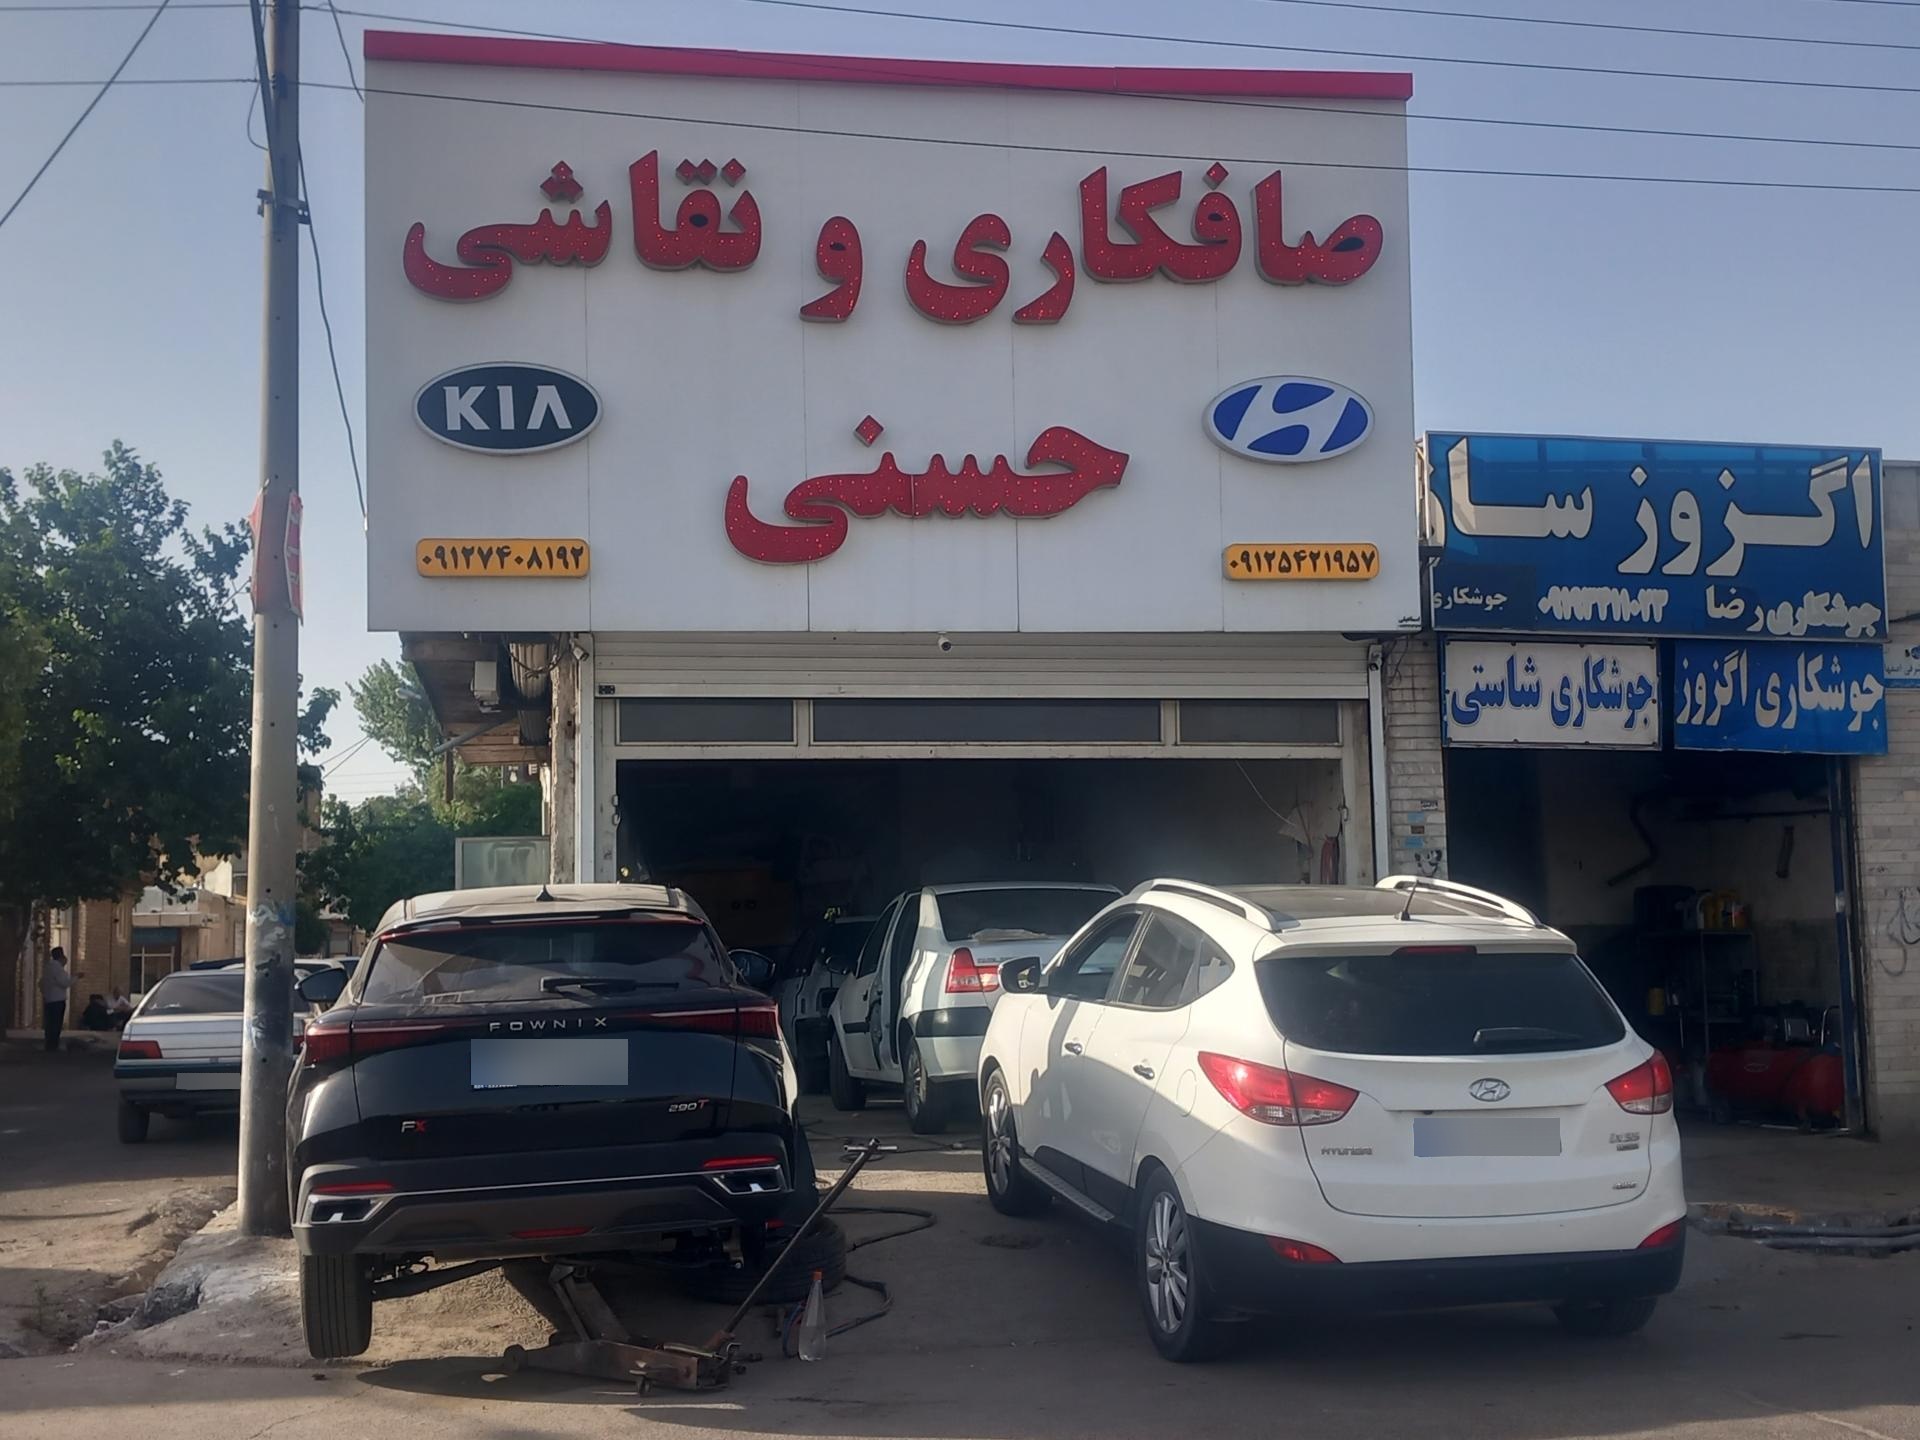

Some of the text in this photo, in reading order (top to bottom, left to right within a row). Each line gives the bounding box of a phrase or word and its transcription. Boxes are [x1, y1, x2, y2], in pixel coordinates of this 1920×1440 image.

[404, 150, 1383, 324] صافکاری و نقاشی
[443, 384, 573, 432] KIA
[725, 415, 1129, 565] حسنی
[1617, 454, 1873, 578] اگزوز
[422, 544, 584, 570] ۰۹۱۲۷۴۰۸۱۹۲
[1229, 549, 1376, 573] ۰۹۱۲۵۴۲۱۹۵۷
[1705, 584, 1882, 638] جوشکاری رضا
[1450, 655, 1654, 728] جوشکاری شاستی
[1676, 649, 1885, 732] جوشکاری اگزوز
[489, 1017, 608, 1032] FOWNIX
[401, 1119, 427, 1133] FX
[668, 1098, 710, 1114] 290T
